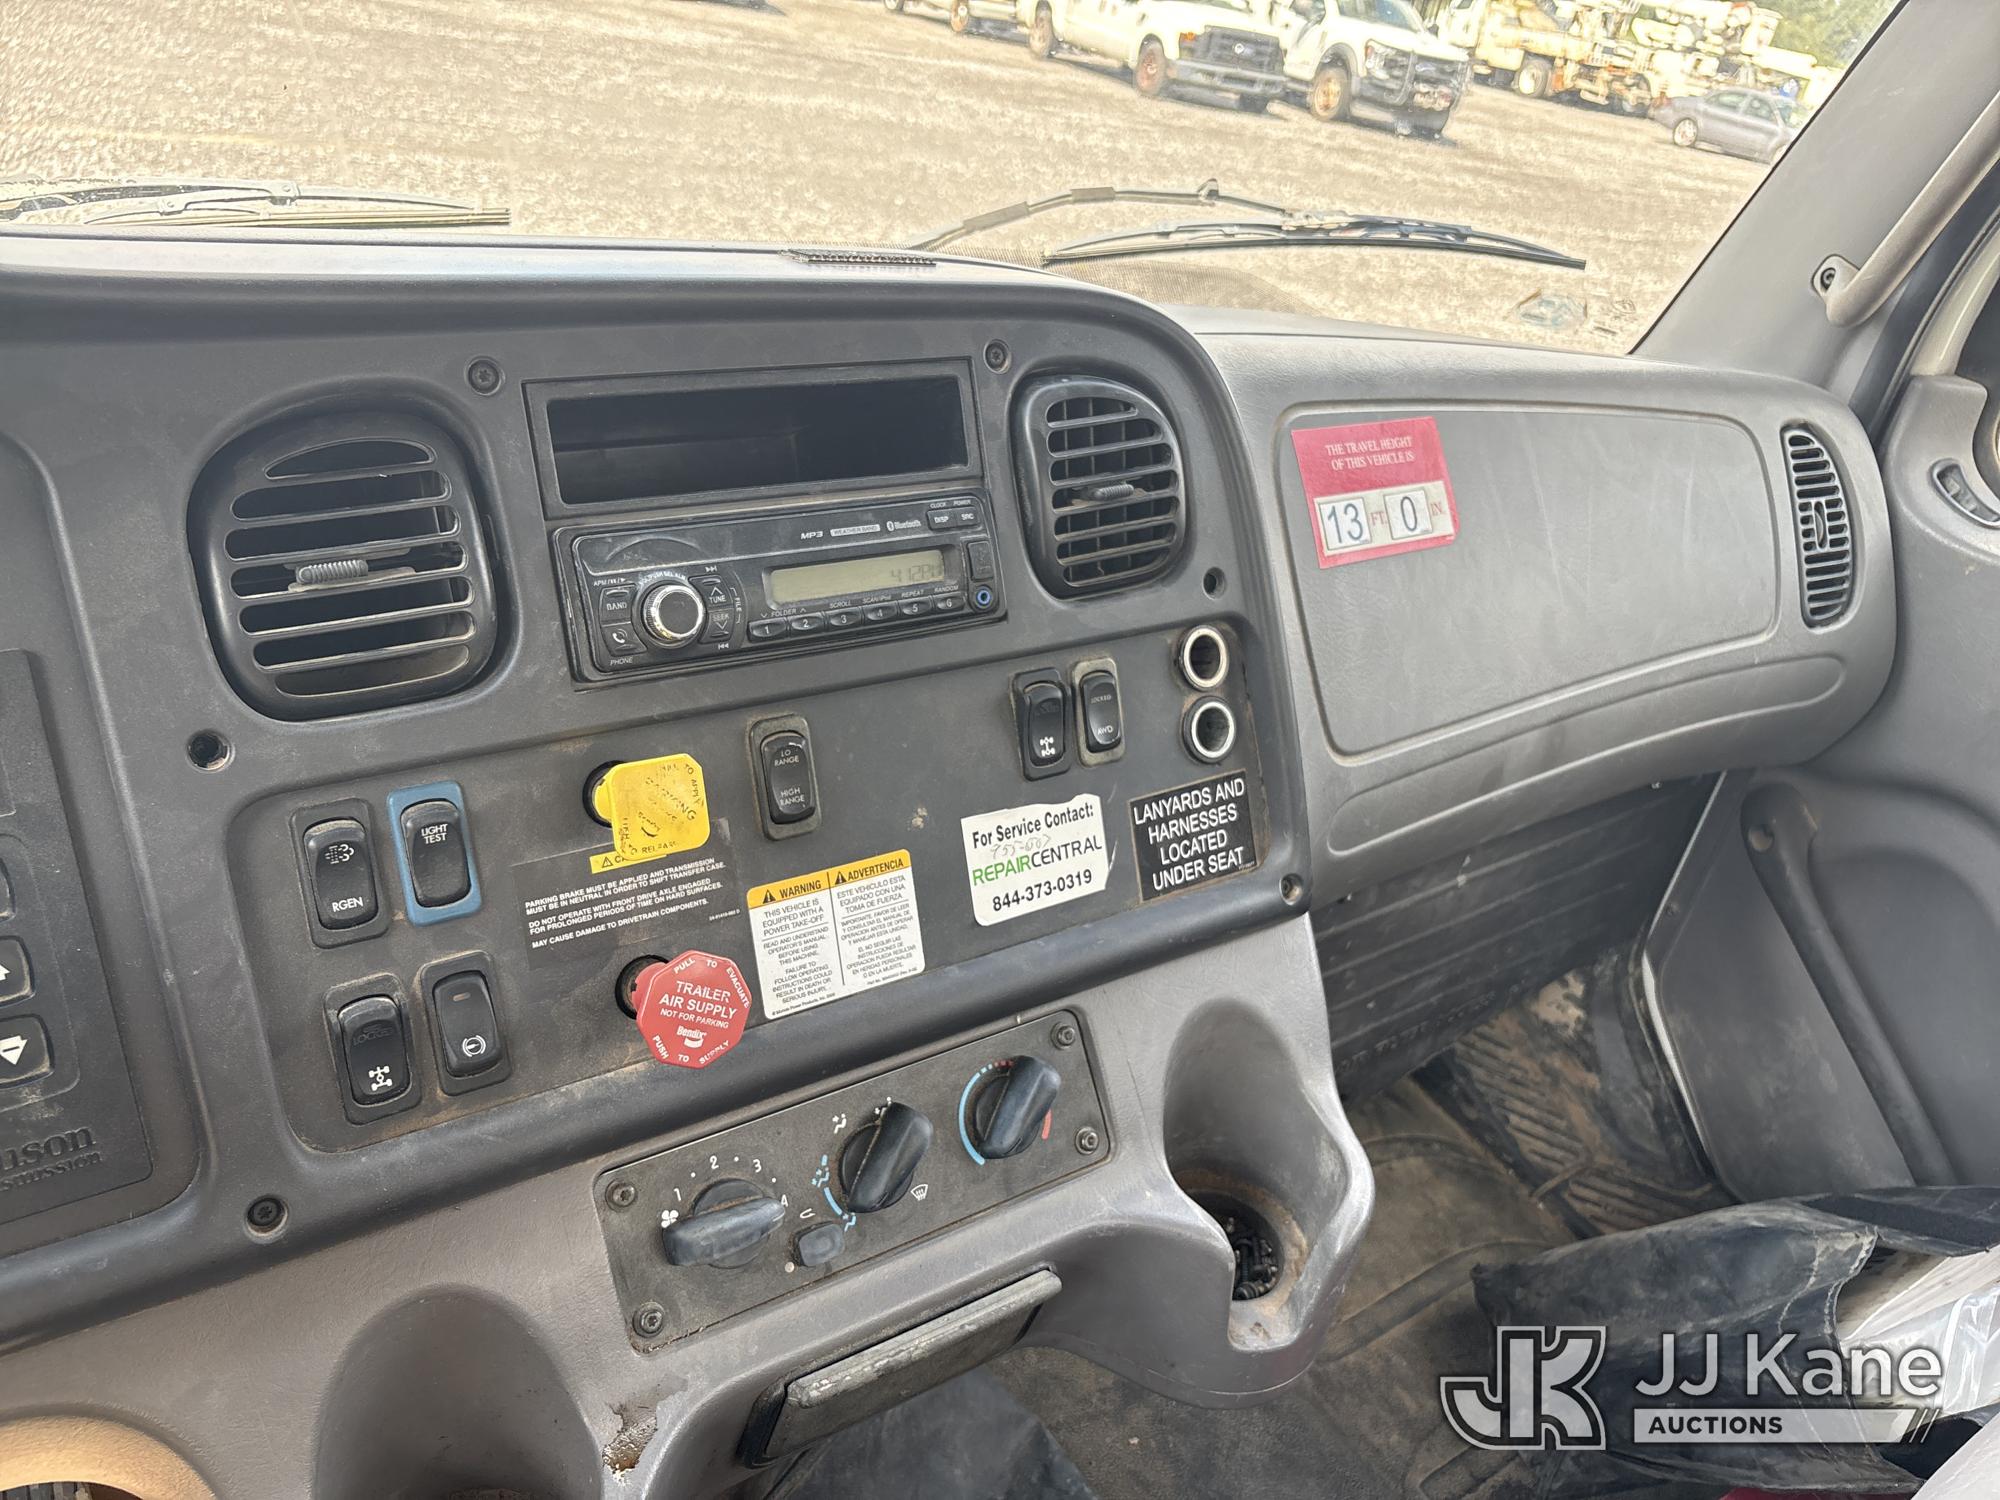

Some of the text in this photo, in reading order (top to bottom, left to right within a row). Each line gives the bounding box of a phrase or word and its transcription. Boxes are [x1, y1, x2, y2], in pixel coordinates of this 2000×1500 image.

[1325, 436, 1412, 456] THE TRAVEL HEIGHT
[1331, 451, 1415, 471] OF THIS VEHICLE IS
[895, 520, 921, 529] Bluetooth
[1327, 503, 1363, 544] 13
[1400, 496, 1417, 532] 0
[801, 531, 823, 540] MP3
[901, 590, 924, 598] REPEAT
[934, 585, 959, 593] RANDOM
[607, 602, 627, 611] BAND
[709, 596, 726, 604] TUNE
[829, 601, 851, 609] SCROLL
[912, 604, 918, 613] 5
[946, 599, 952, 607] 6
[712, 613, 729, 621] SEEK
[771, 608, 797, 617] FOLDER
[841, 615, 847, 623] 3
[877, 609, 883, 618] 4
[765, 625, 770, 634] 1
[803, 619, 809, 628] 2
[610, 657, 633, 666] PHONE
[1097, 725, 1113, 735] AWD
[775, 755, 799, 766] RANGE
[780, 794, 805, 806] RANGE
[781, 787, 800, 797] HIGH
[1134, 778, 1244, 825] LANYARDS AND
[421, 823, 448, 836] LIGHT
[972, 803, 1094, 848] For Service Contact:
[1148, 803, 1238, 844] HARNESSES
[424, 833, 447, 844] TEST
[1160, 830, 1227, 865] LOCATED
[846, 857, 903, 881] ADVERTENCIA
[1152, 846, 1244, 891] UNDER SEAT
[525, 857, 714, 908] PARKING BRAKE MUST BE APPLIED AND TRANSMISSION
[526, 904, 547, 915] MUST
[548, 901, 559, 909] BE
[569, 891, 603, 904] NEUTRAL
[612, 882, 637, 894] ORDER
[637, 880, 648, 888] TO
[649, 875, 668, 885] SHIFT
[669, 866, 704, 880] TRANSFER
[706, 861, 726, 871] CASE.
[779, 879, 821, 899] WARNING
[992, 869, 1092, 912] 844-373-0319
[528, 877, 710, 928] DO NOT OPERATE WITH FRONT DRIVE AXLE ENGAGED
[839, 883, 905, 907] EQUIPADO CON UNA
[845, 892, 902, 914] TOMA DE FUERZA
[332, 897, 364, 912] RGEN
[529, 880, 723, 935] FOR PROLONGED PERIODS OF TIME ON HARD SURFACES.
[764, 897, 819, 918] THIS VEHICLE IS
[531, 938, 547, 948] MAY
[549, 931, 574, 943] CAUSE
[575, 923, 605, 937] DAMAGE
[606, 921, 616, 929] TO
[617, 910, 659, 926] DRIVETRAIN
[660, 897, 709, 915] COMPONENTS.
[762, 905, 823, 928] EQUIPPED WITH A
[763, 913, 824, 936] POWER TAKE-OFF
[763, 926, 828, 949] READ AND UNDERSTAND
[674, 958, 750, 1009] PULL TO EVACUATE
[676, 981, 731, 1003] TRAILER
[659, 994, 737, 1020] AIR SUPPLY
[660, 1008, 729, 1029] NOT FOR PARKING
[676, 1026, 704, 1039] Bendix
[652, 1035, 729, 1064] PUSH TO SUPPLY
[710, 1155, 719, 1169] 2
[753, 1159, 762, 1173] 3
[674, 1188, 681, 1201] 1
